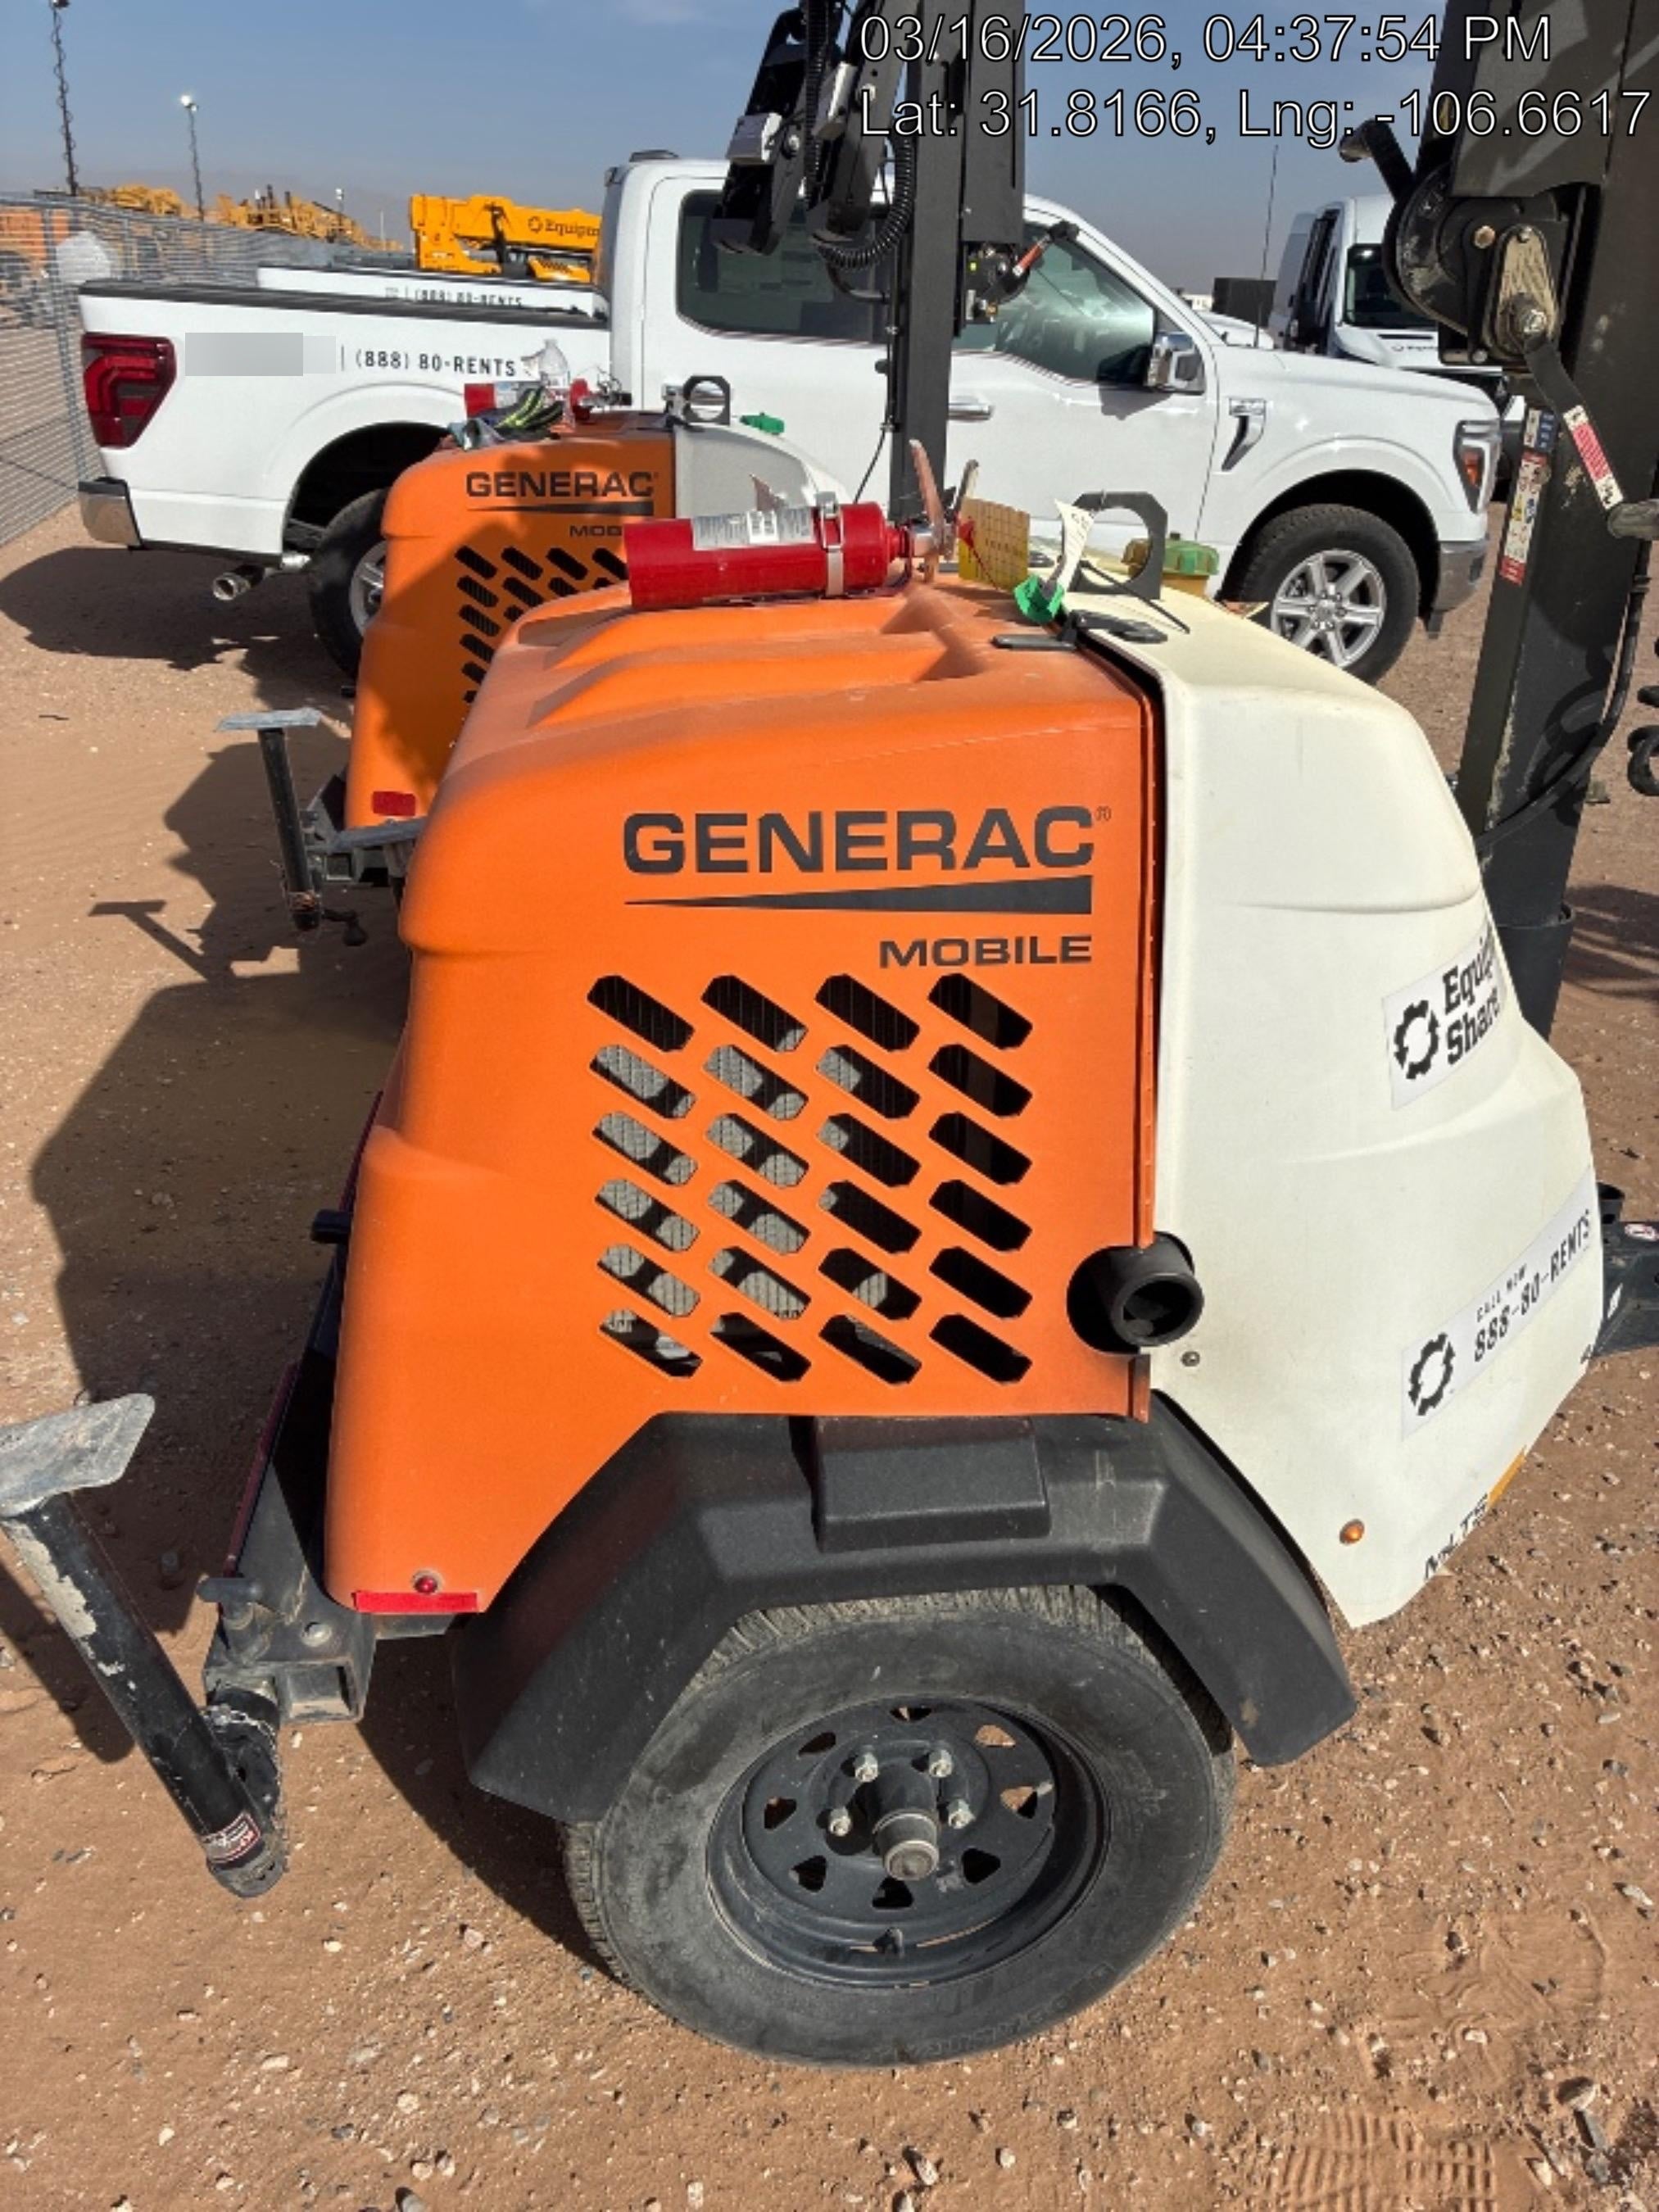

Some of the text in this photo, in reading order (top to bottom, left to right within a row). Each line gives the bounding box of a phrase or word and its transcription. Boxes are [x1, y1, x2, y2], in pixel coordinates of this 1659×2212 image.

[356, 348, 515, 377] (888) 80-RENTS
[466, 471, 654, 497] GENERAC
[623, 805, 1095, 876] GENERAC
[879, 936, 1093, 968] MOBILE
